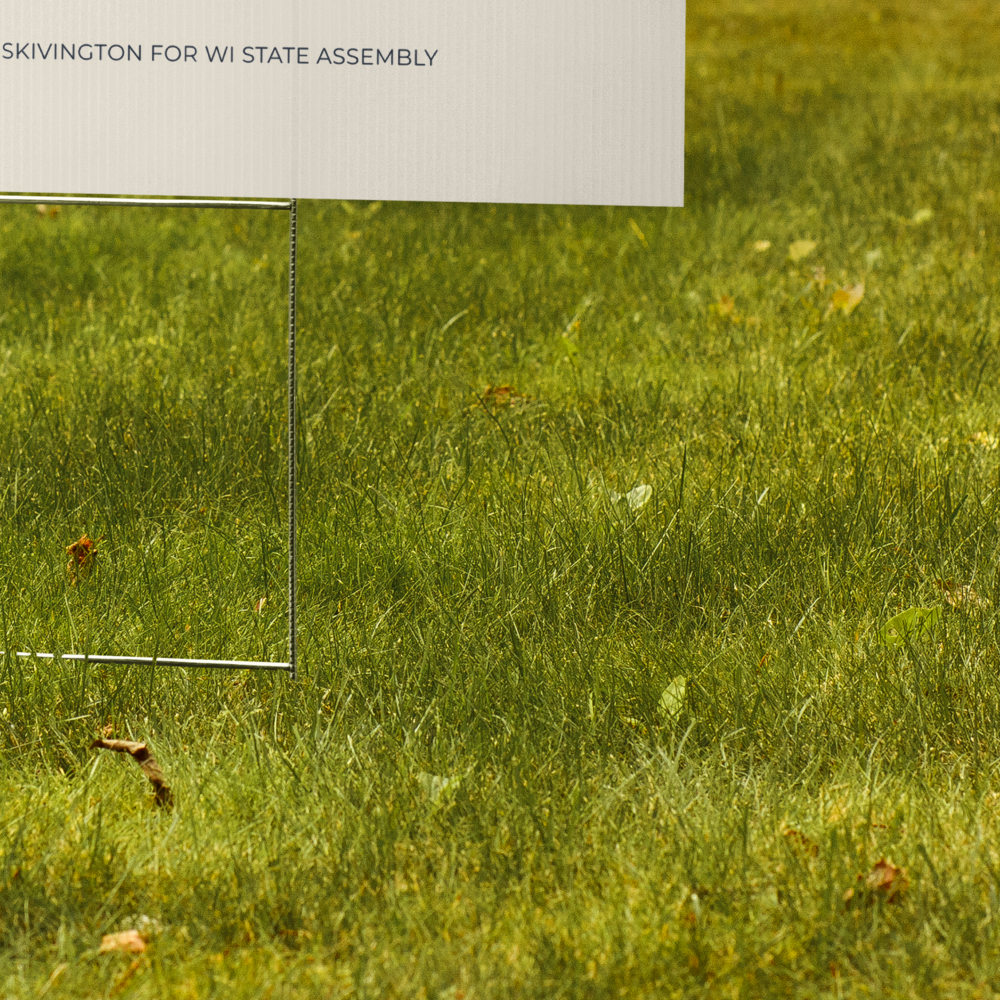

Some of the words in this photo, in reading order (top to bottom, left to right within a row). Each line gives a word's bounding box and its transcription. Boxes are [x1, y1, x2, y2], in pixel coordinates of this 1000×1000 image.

[2, 42, 142, 62] SKIVINGTON
[151, 44, 198, 63] FOR
[205, 45, 234, 63] WI
[242, 46, 310, 64] STATE
[316, 47, 439, 67] ASSEMBLY
